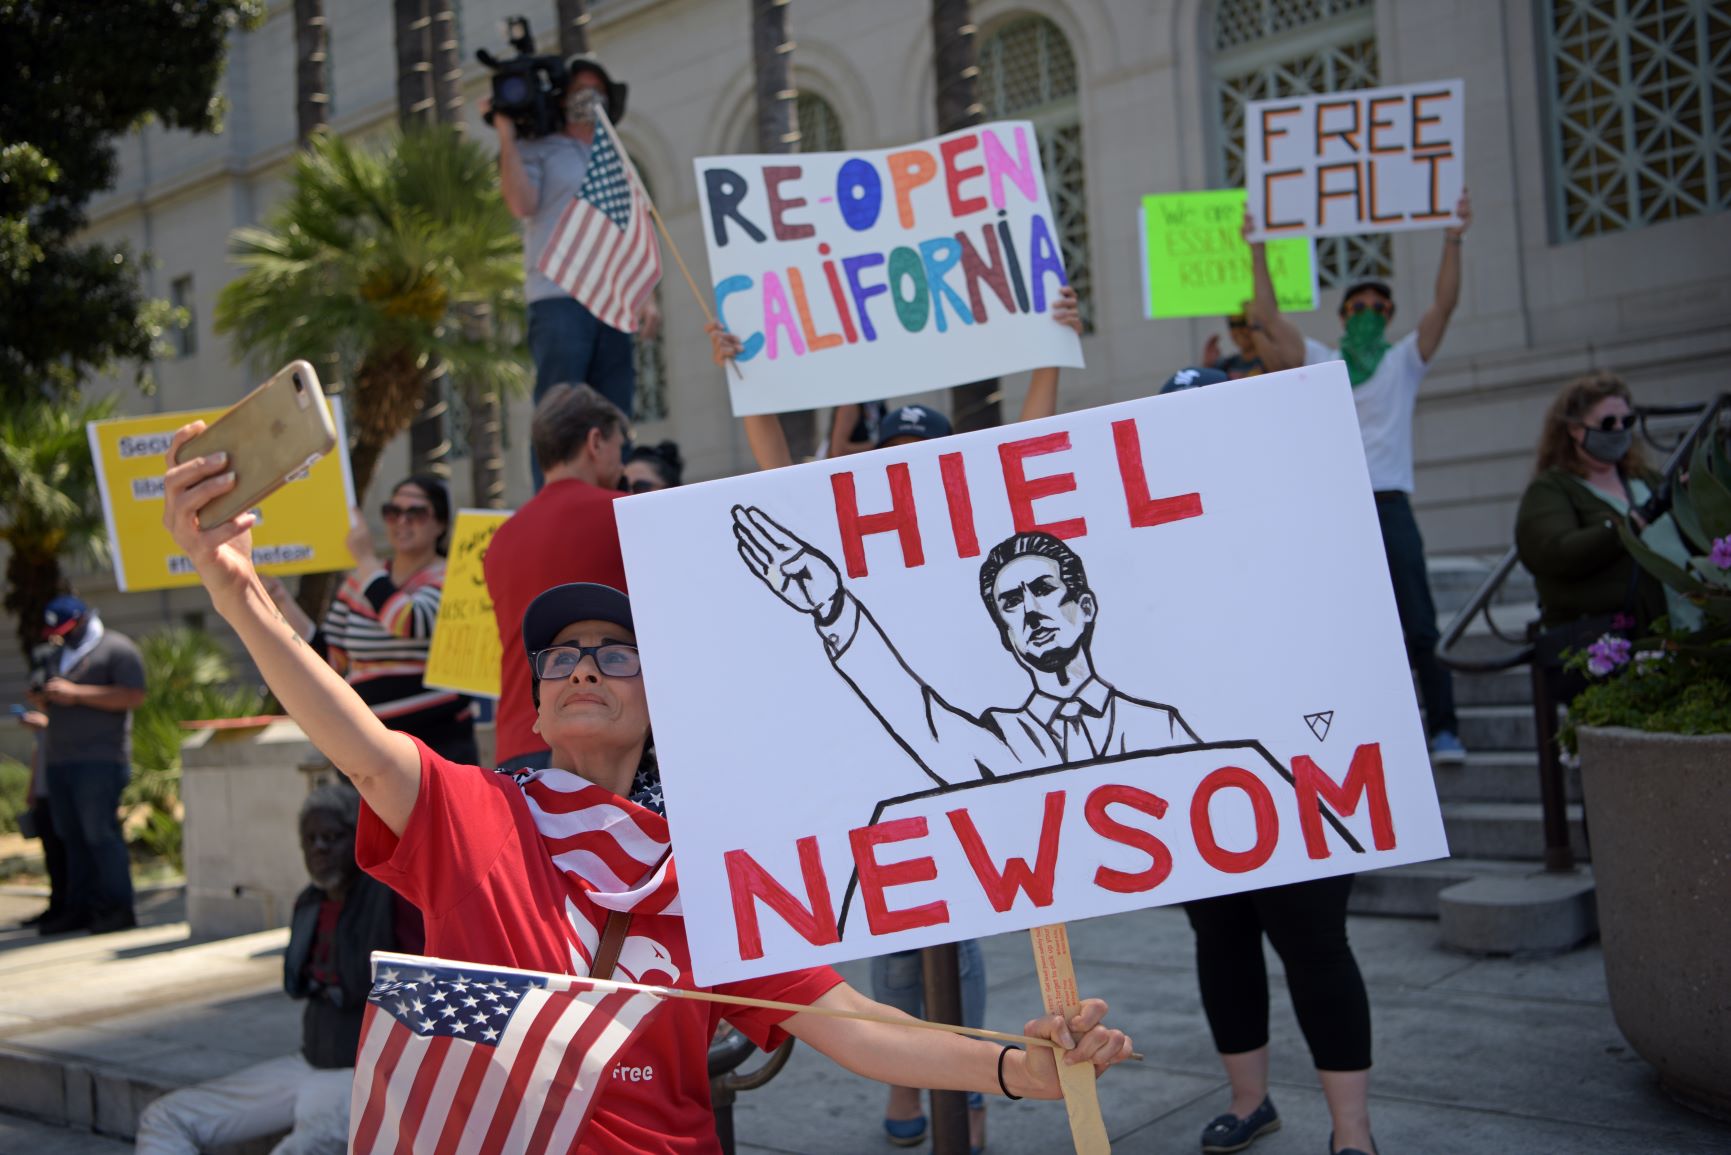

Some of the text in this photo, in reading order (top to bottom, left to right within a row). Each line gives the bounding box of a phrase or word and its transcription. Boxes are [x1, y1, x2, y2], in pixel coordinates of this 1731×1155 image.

[704, 126, 1037, 248] RE-OPEN
[1262, 90, 1452, 164] FREE
[1264, 152, 1454, 231] CALI
[831, 418, 1203, 578] HIEL
[724, 742, 1397, 960] NEWSOM
